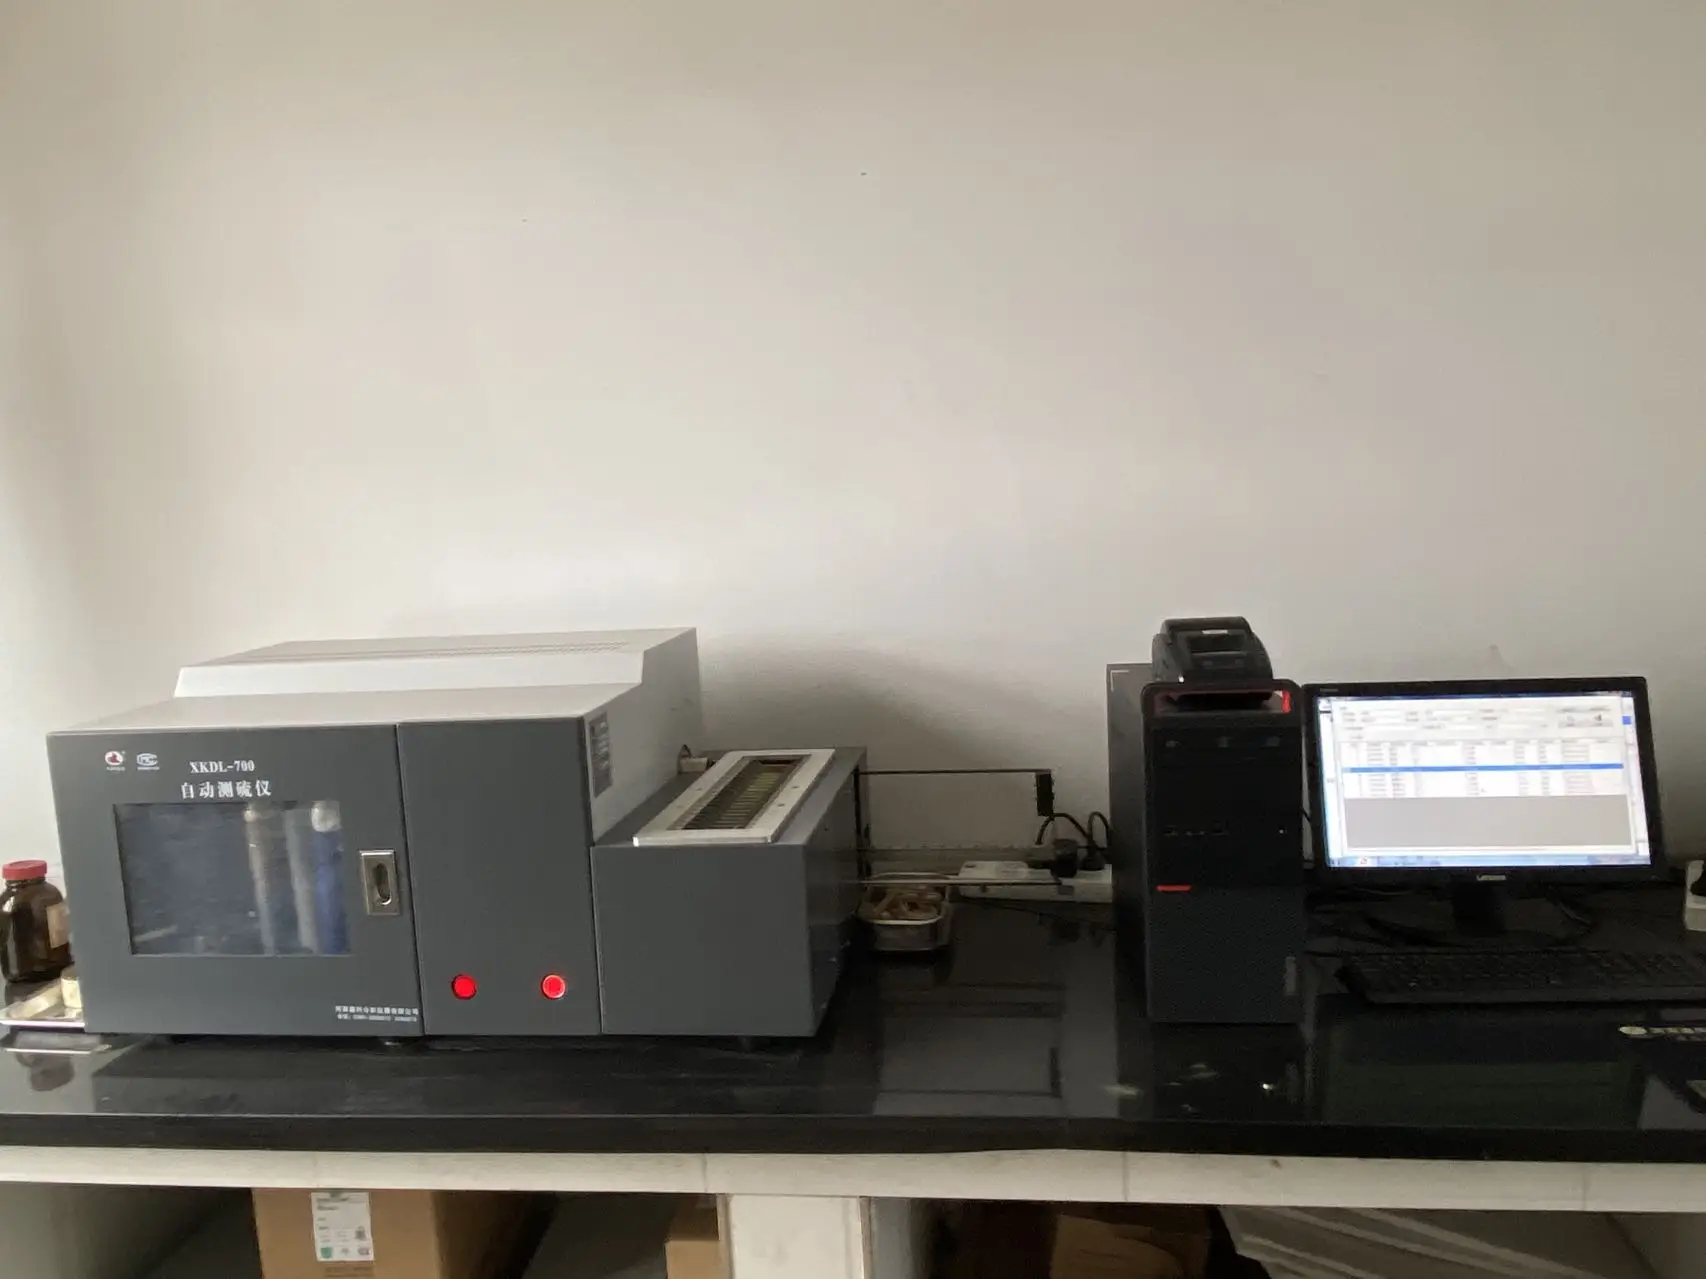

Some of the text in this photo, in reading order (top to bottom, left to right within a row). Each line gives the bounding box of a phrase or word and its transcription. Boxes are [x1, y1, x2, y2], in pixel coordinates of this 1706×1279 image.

[189, 760, 255, 773] XKDL-700
[181, 780, 271, 799] 自动测硫仪
